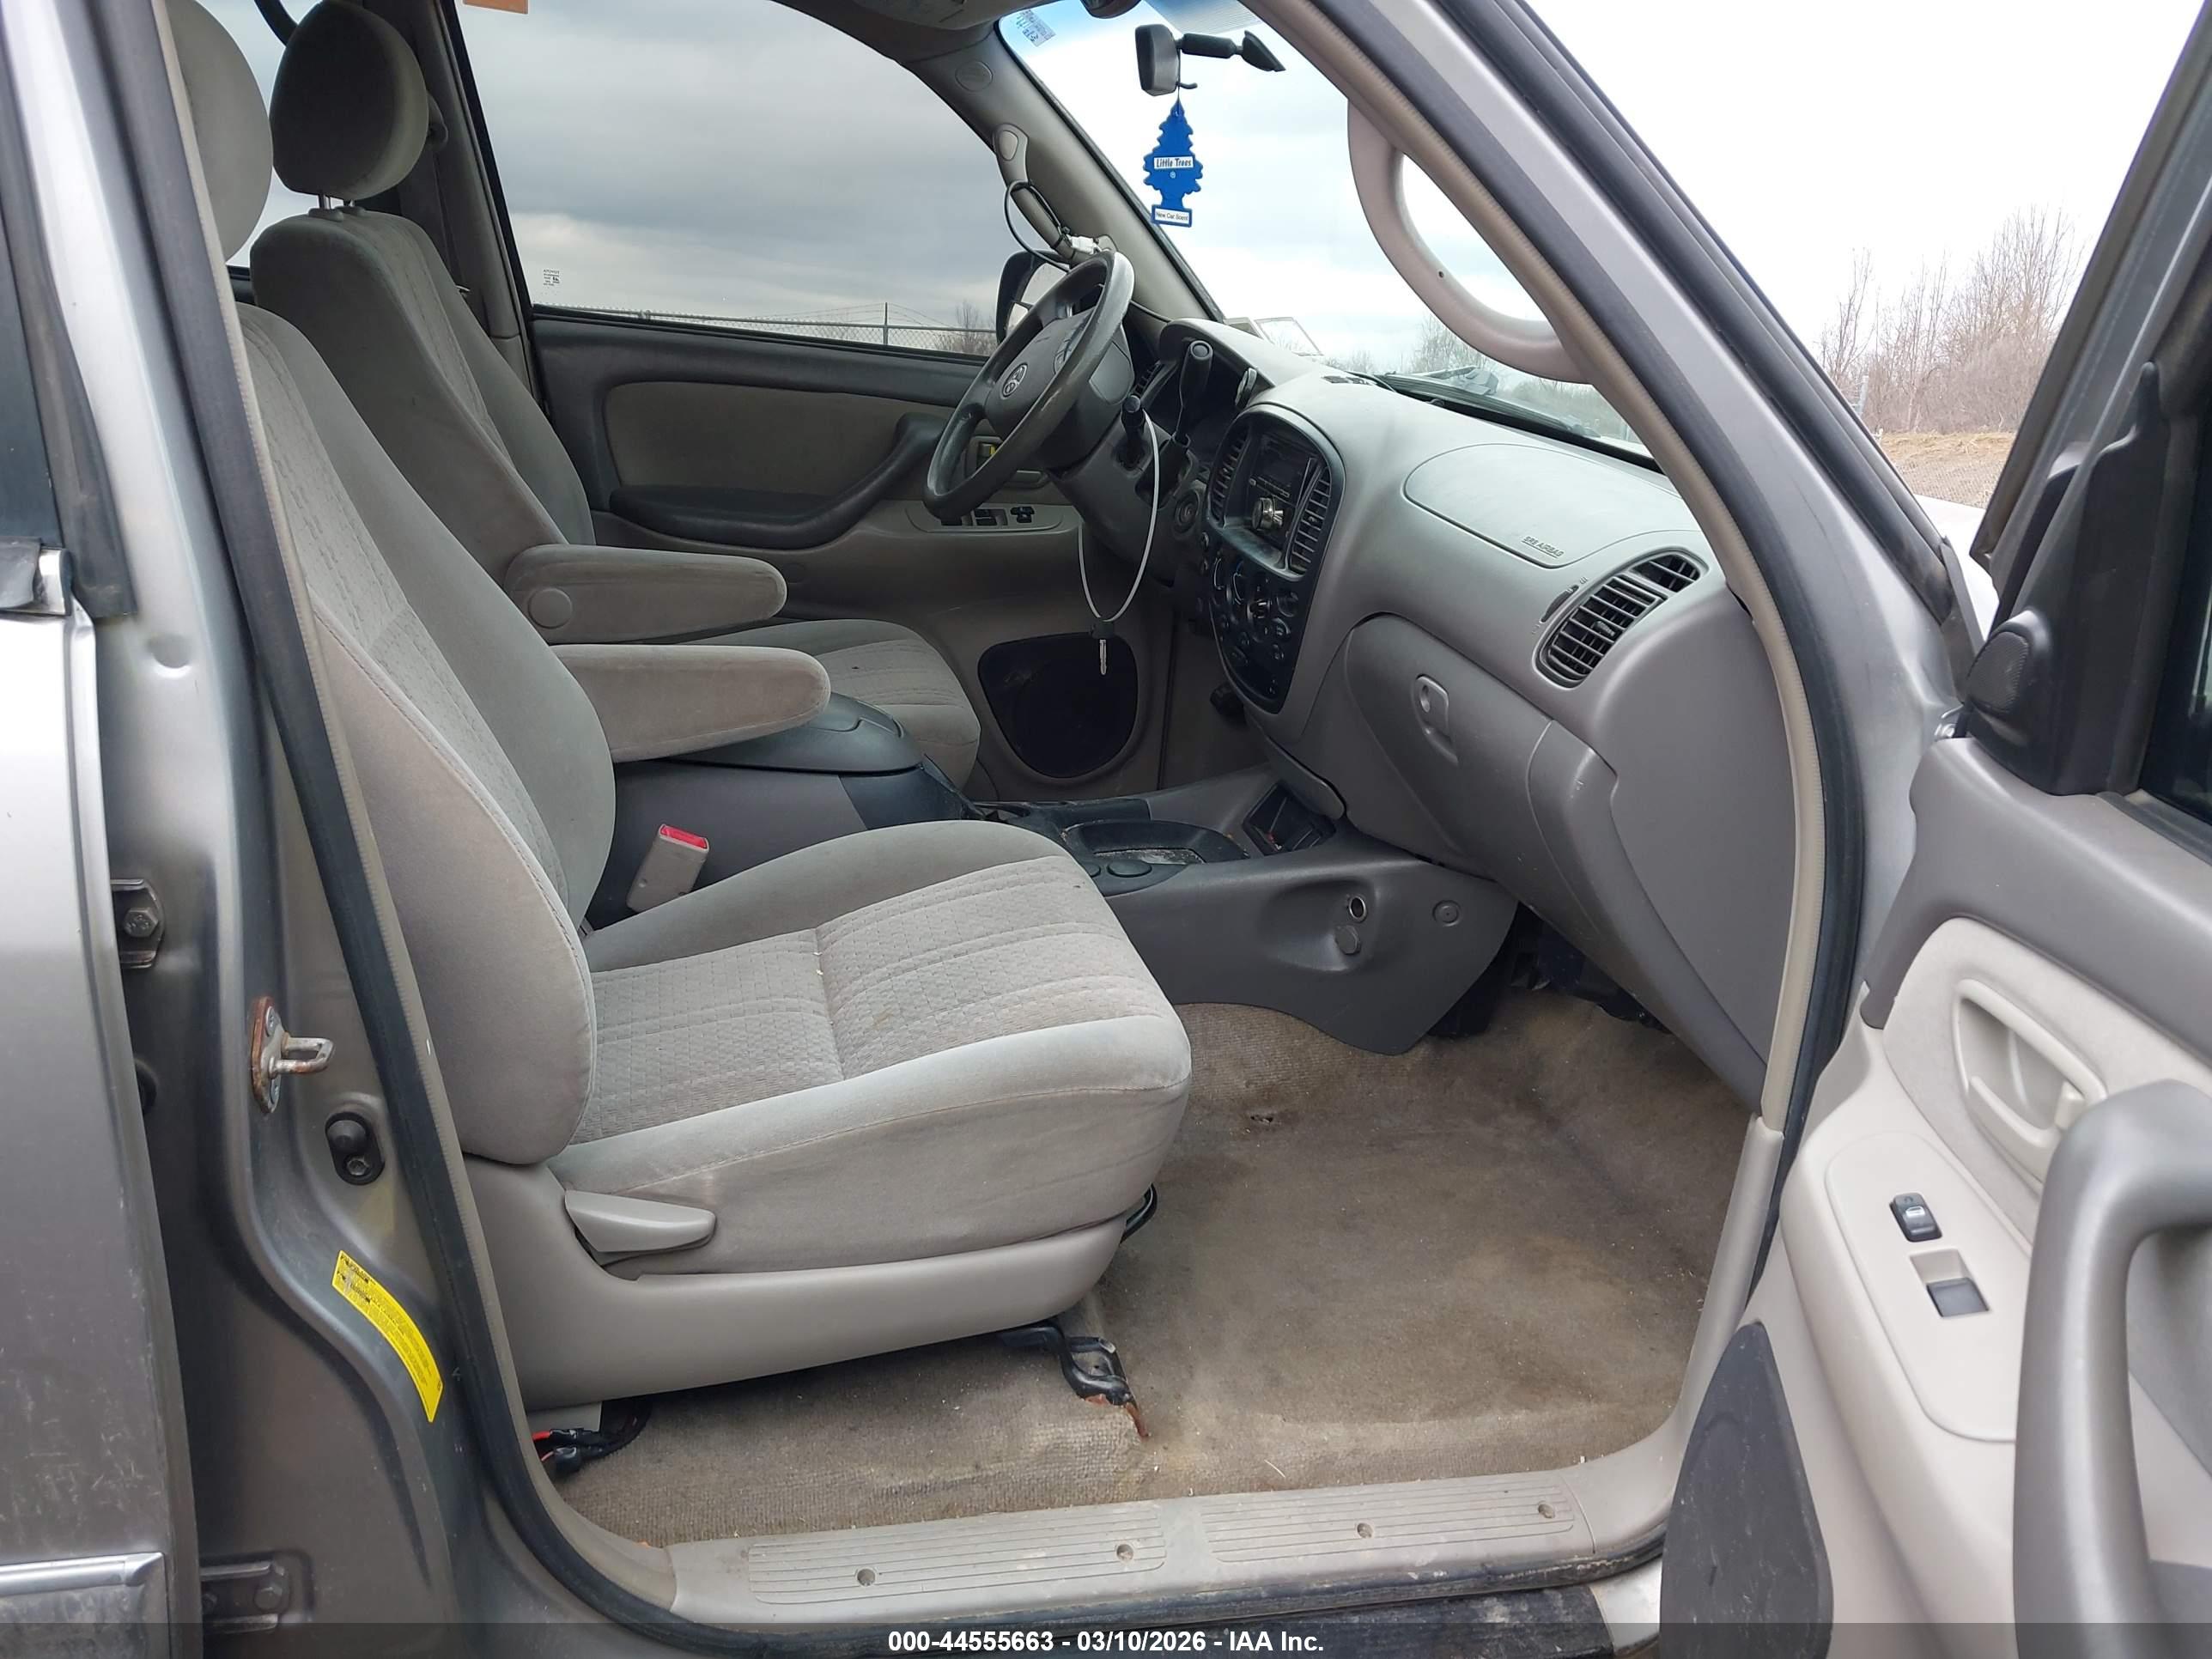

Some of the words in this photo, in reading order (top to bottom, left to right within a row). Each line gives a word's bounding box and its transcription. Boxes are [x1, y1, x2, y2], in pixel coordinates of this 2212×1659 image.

[1156, 158, 1173, 168] Little
[1175, 157, 1192, 167] Trees
[1176, 213, 1188, 222] Scent
